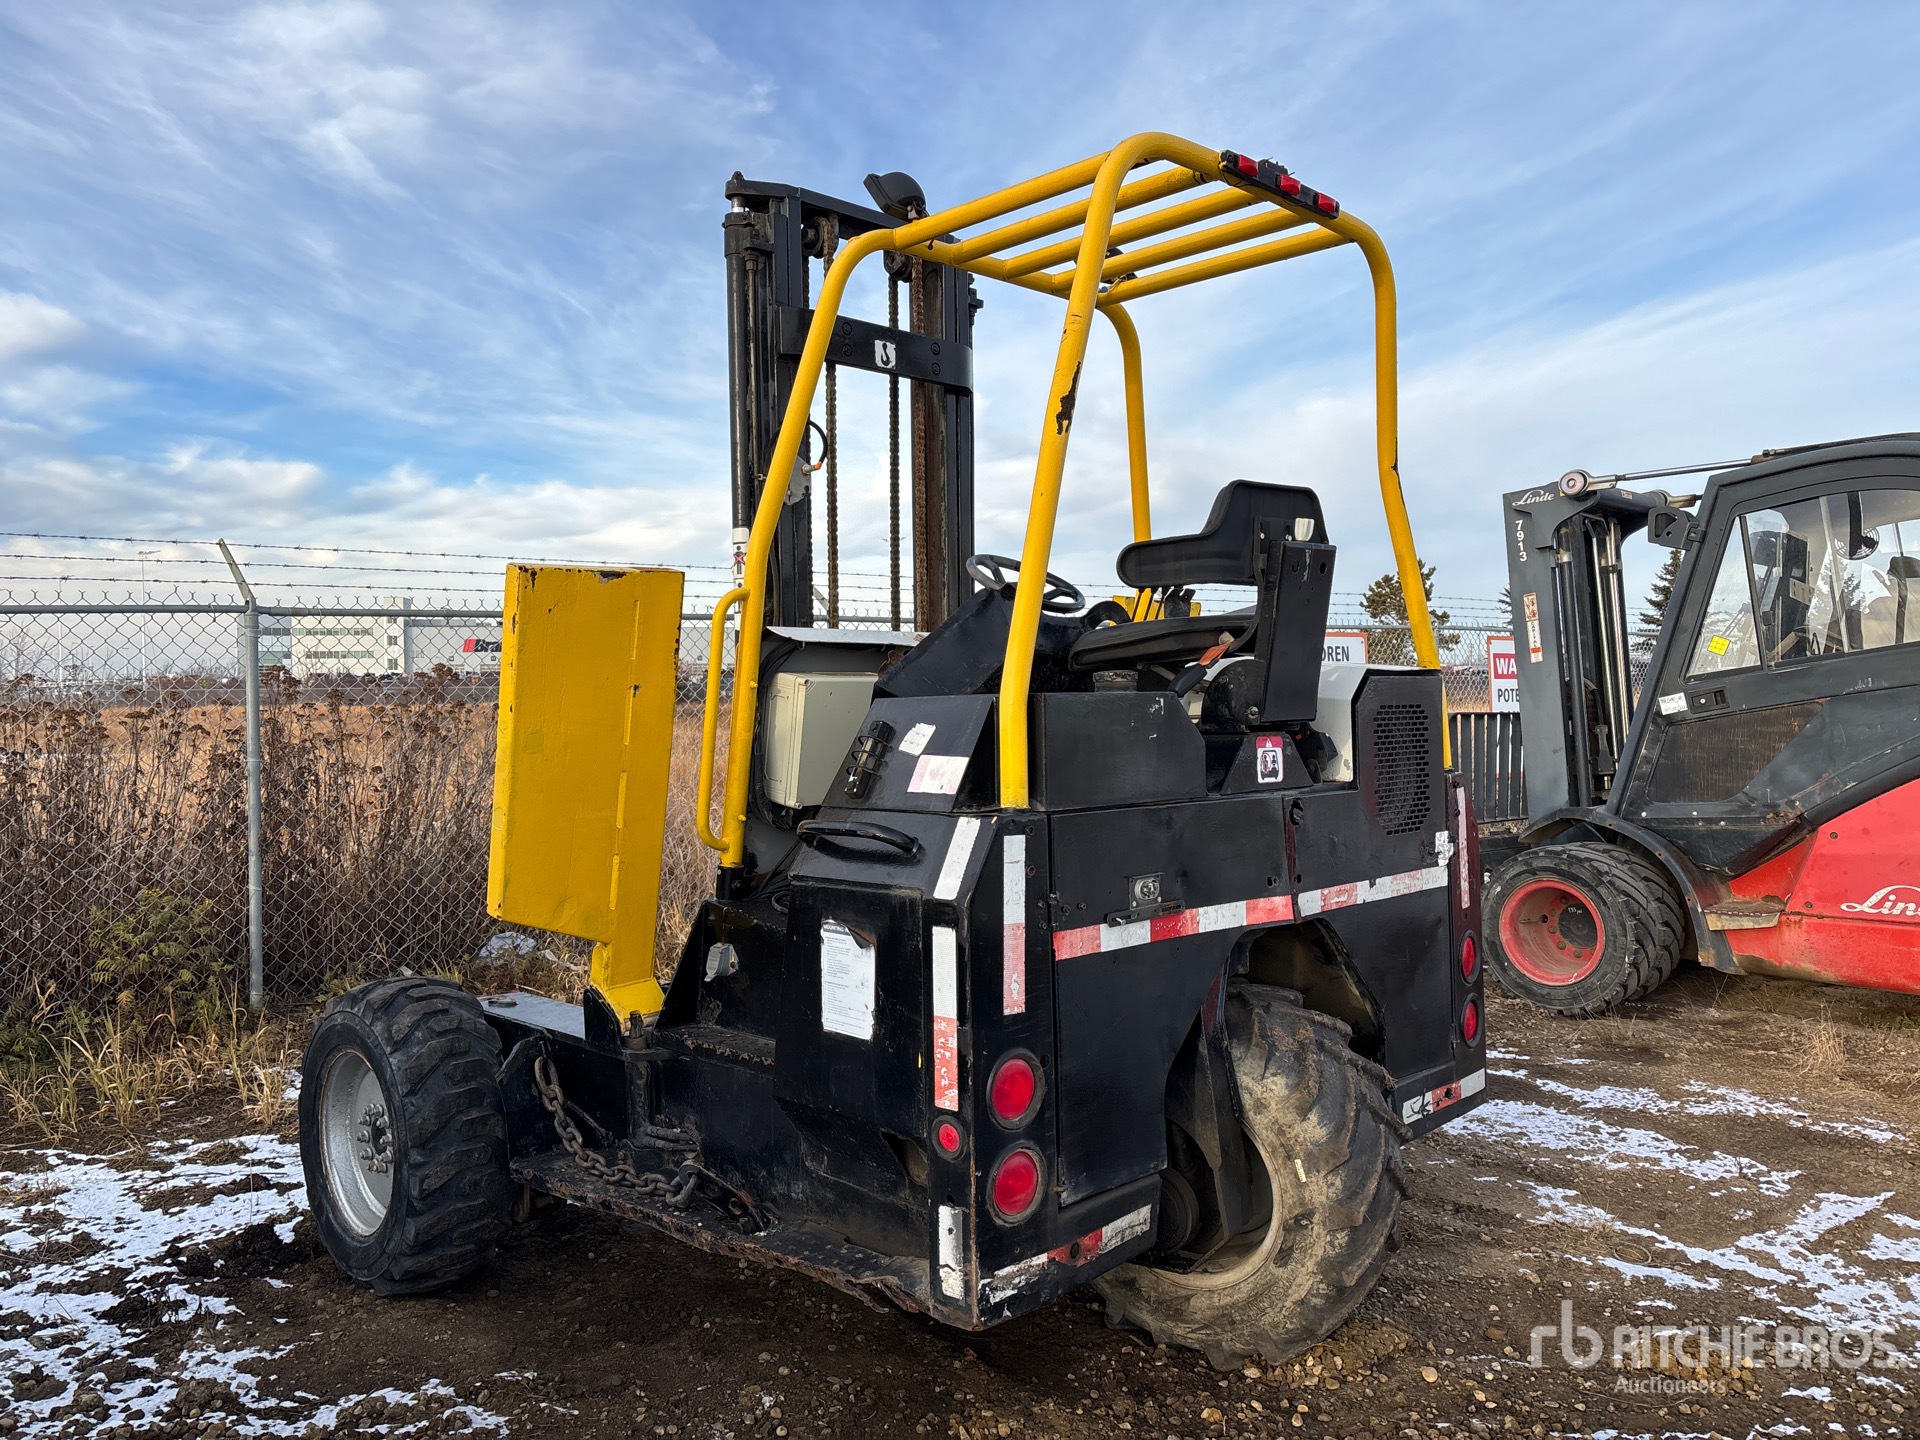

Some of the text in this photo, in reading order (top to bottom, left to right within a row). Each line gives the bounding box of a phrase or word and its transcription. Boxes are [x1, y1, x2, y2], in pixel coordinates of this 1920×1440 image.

[1511, 489, 1555, 507] Linde
[1515, 519, 1528, 562] 7913
[1530, 621, 1538, 648] CAPITAL
[1840, 885, 1920, 917] Lin
